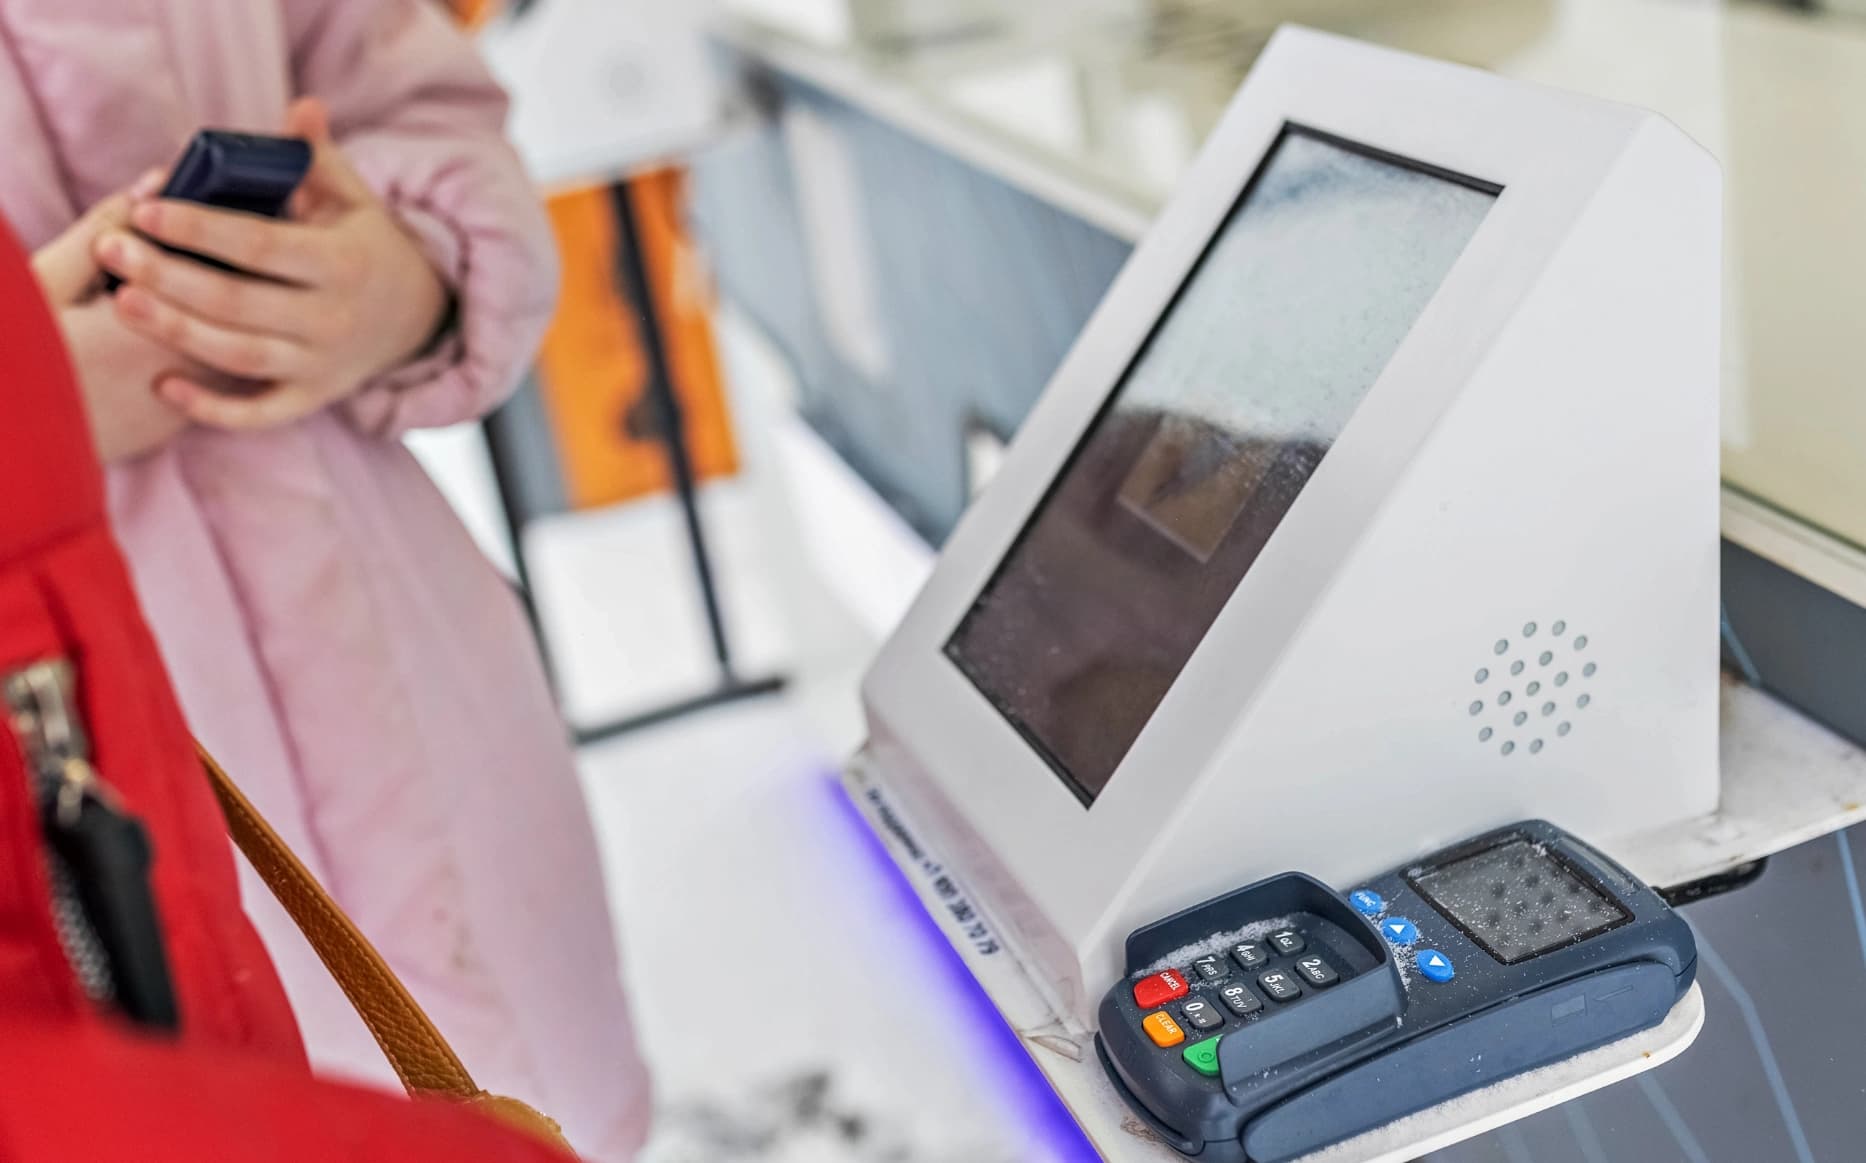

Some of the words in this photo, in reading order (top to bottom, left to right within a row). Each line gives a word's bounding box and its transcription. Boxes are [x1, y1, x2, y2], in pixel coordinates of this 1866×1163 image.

[1236, 944, 1255, 952] 4
[1196, 955, 1215, 965] 7
[1302, 958, 1321, 968] 2
[1307, 966, 1325, 980] ABC
[1159, 972, 1182, 991] CANCEL
[1264, 974, 1284, 983] 5
[1224, 987, 1243, 997] 8
[1270, 981, 1286, 994] JKL
[1185, 1002, 1205, 1011] 0
[1231, 995, 1247, 1009] TUV
[1155, 1013, 1178, 1034] CLEAR
